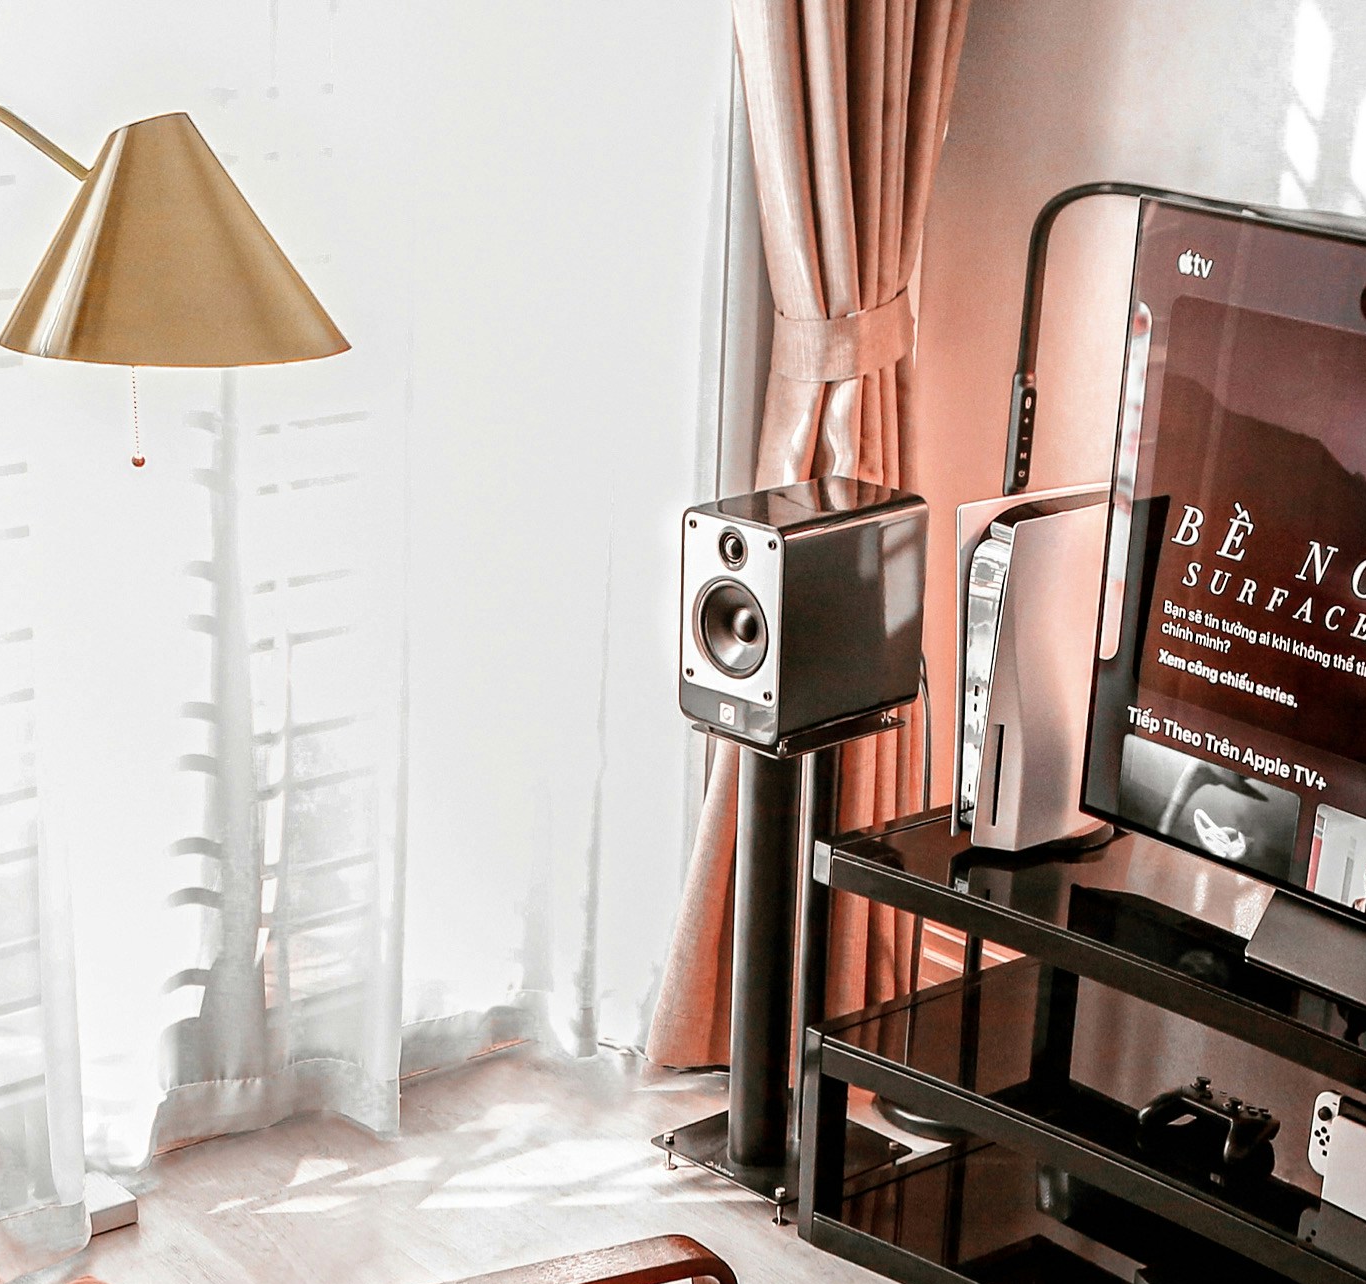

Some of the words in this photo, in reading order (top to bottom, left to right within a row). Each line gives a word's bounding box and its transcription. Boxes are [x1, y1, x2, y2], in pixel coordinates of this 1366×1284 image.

[1171, 502, 1255, 562] BỀ
[1161, 621, 1194, 643] chính
[1195, 631, 1231, 654] mình?
[1163, 599, 1187, 621] Bạn
[1188, 607, 1202, 623] sẽ
[1204, 613, 1220, 629] tin
[1221, 618, 1257, 645] tưởng
[1258, 631, 1270, 645] ai
[1271, 633, 1291, 652] khi
[1292, 638, 1331, 668] không
[1333, 655, 1355, 673] thể
[1158, 648, 1187, 671] Xem
[1187, 657, 1219, 685] công
[1219, 671, 1254, 695] chiếu
[1255, 682, 1299, 708] series.
[1127, 705, 1161, 733] Tiếp
[1163, 718, 1202, 748] Theo
[1205, 732, 1240, 761] Trên
[1242, 748, 1291, 780] Apple
[1293, 764, 1327, 791] TV+
